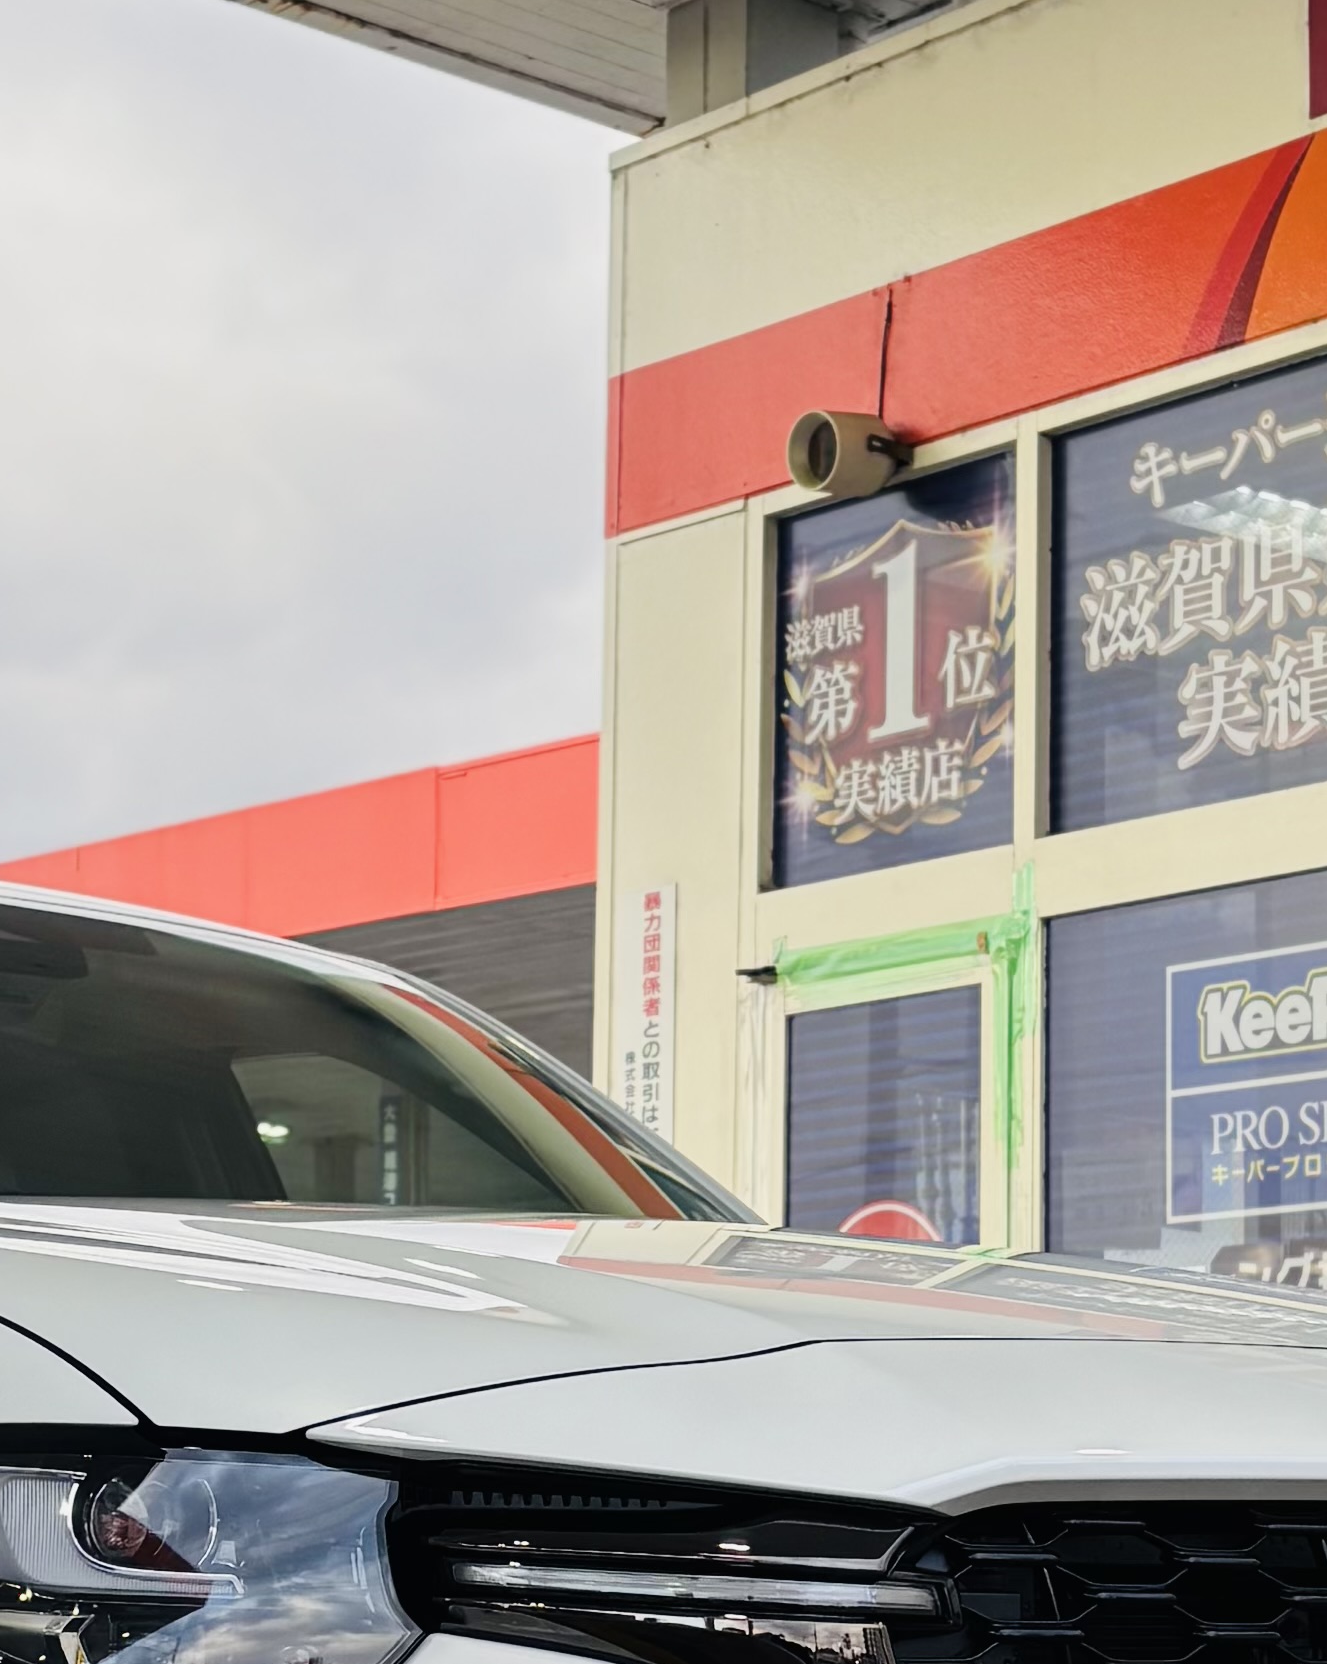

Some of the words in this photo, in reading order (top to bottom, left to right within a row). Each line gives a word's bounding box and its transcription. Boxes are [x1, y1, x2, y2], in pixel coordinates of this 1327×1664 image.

[784, 605, 863, 656] 滋賀県
[834, 738, 965, 823] 実績店
[1210, 1106, 1289, 1155] PRO
